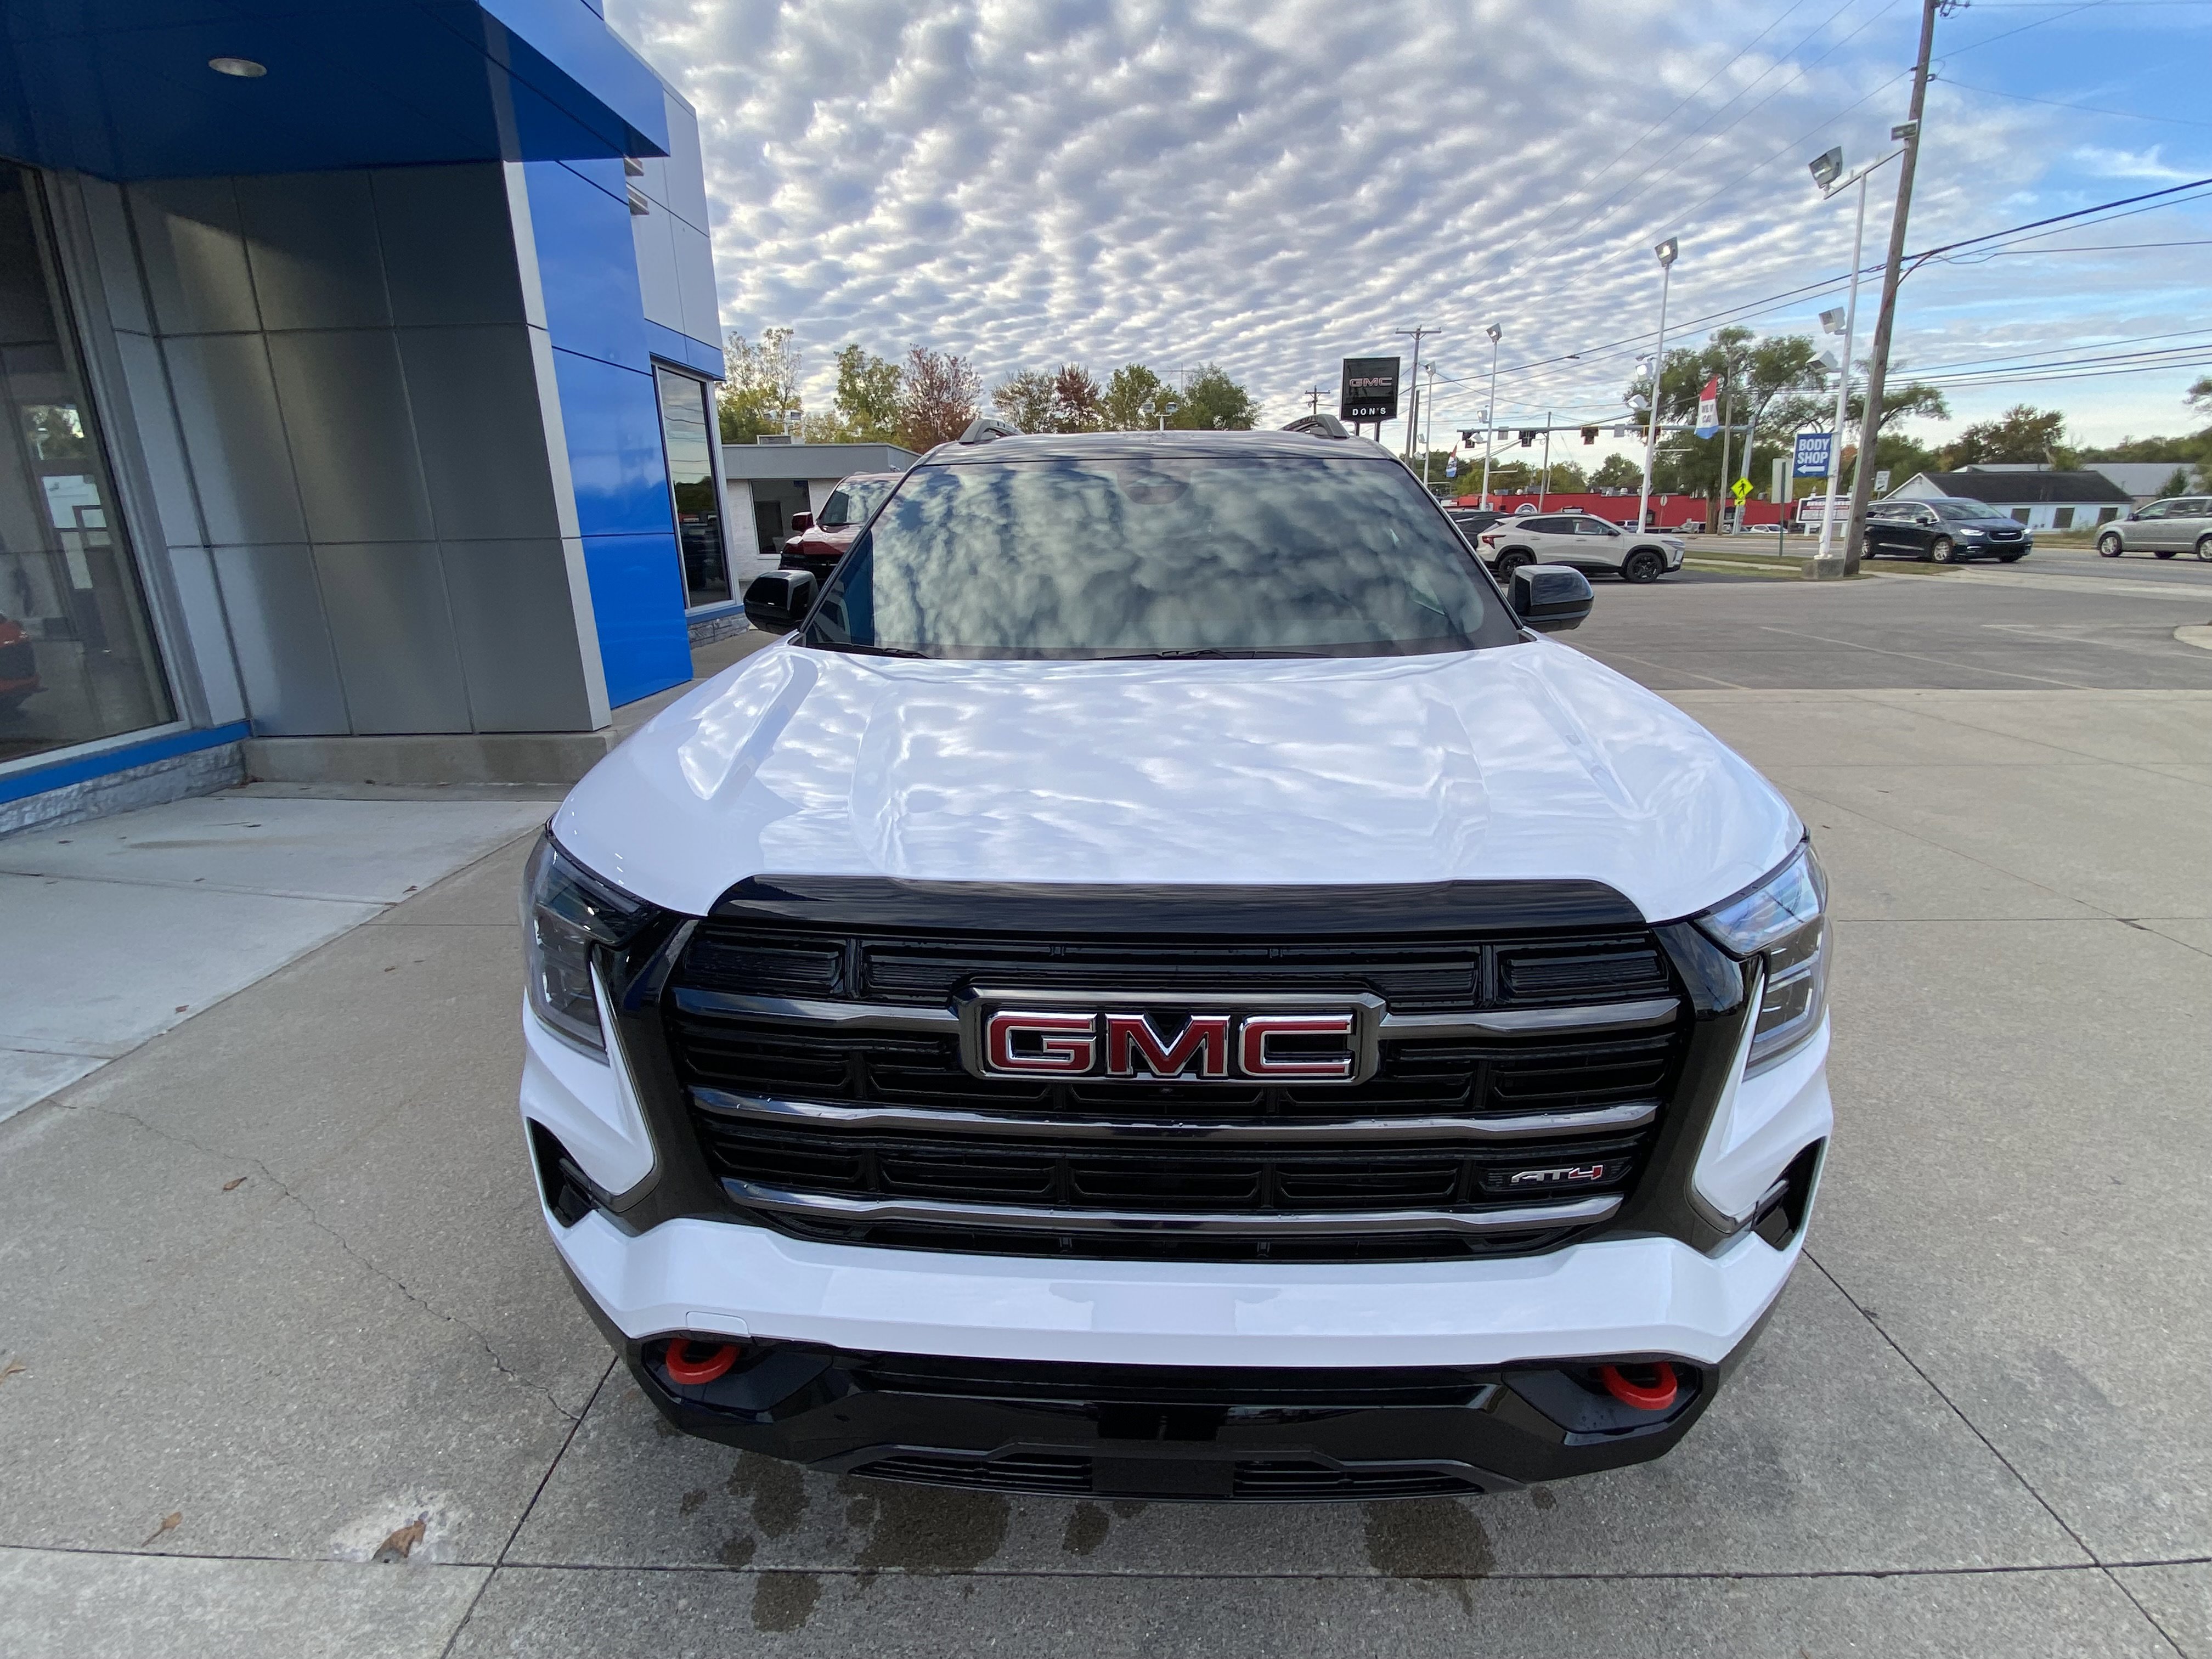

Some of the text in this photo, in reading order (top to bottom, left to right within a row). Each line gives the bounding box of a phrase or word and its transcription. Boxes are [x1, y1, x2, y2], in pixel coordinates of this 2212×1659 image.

[1350, 377, 1392, 387] GMC
[1352, 407, 1386, 416] DON'S
[1799, 438, 1830, 451] BODY
[1797, 452, 1829, 464] SHOP
[988, 1012, 1353, 1077] GMC
[1511, 1165, 1603, 1183] AT4
